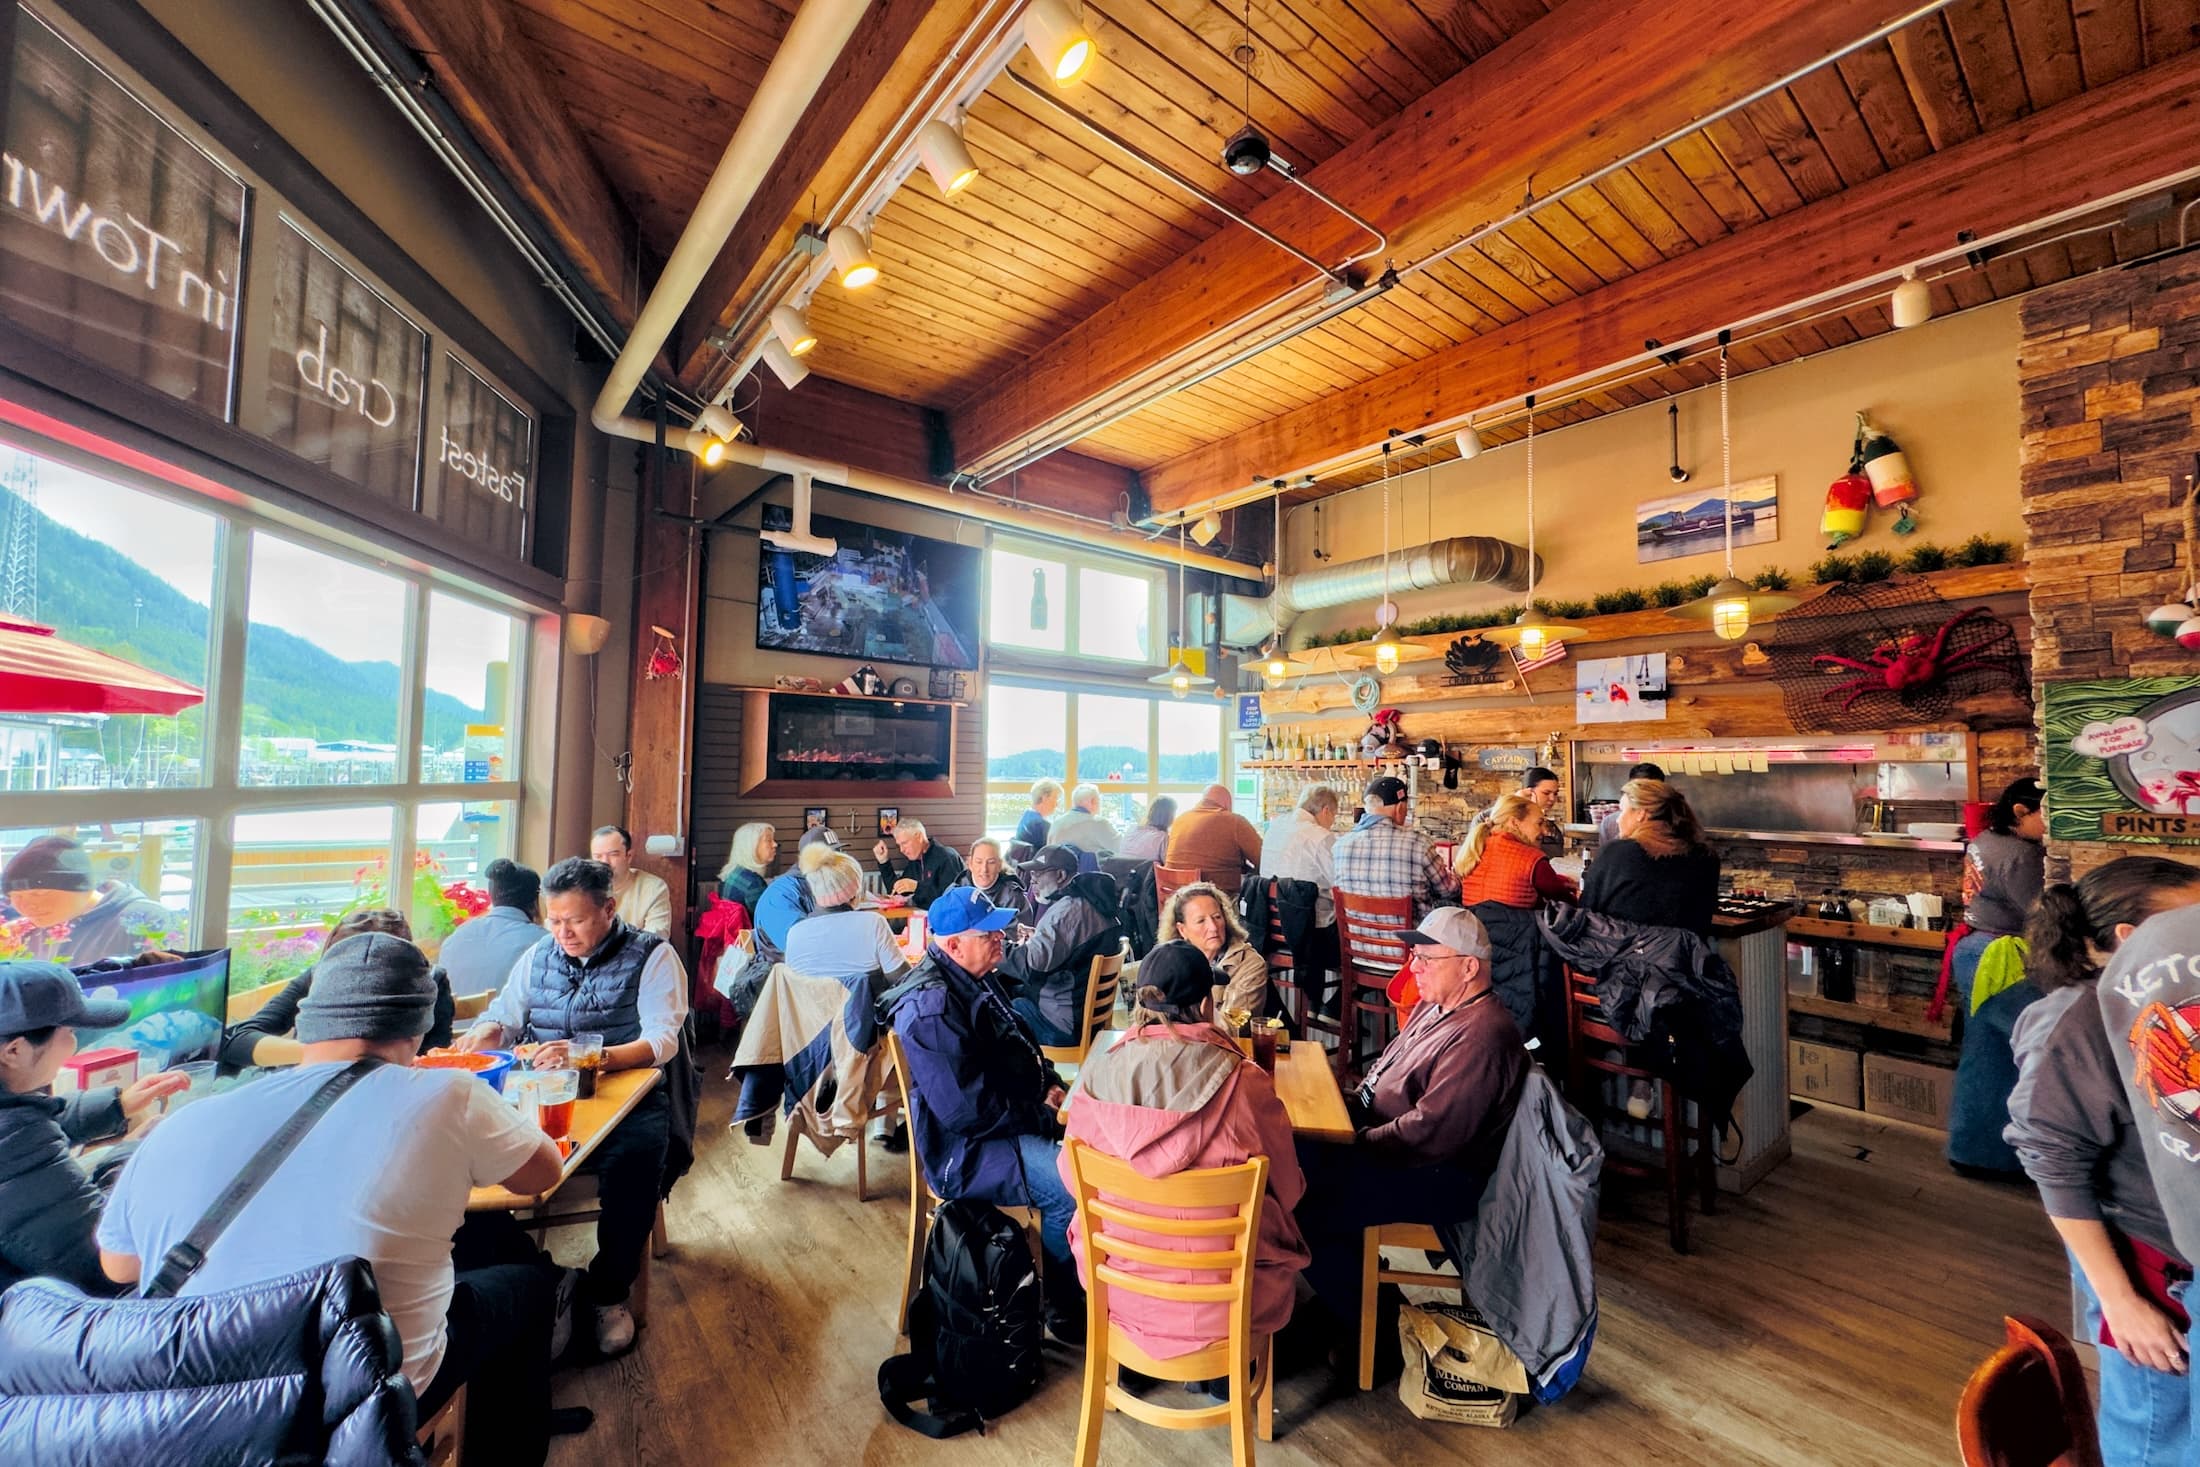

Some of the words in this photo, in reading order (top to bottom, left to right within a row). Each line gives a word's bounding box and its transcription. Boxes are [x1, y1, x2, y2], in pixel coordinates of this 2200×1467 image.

[2088, 724, 2136, 741] AVAILABLE
[2104, 735, 2122, 744] FOR
[2115, 816, 2187, 833] PINTS
[1444, 1380, 1489, 1392] COMPANY
